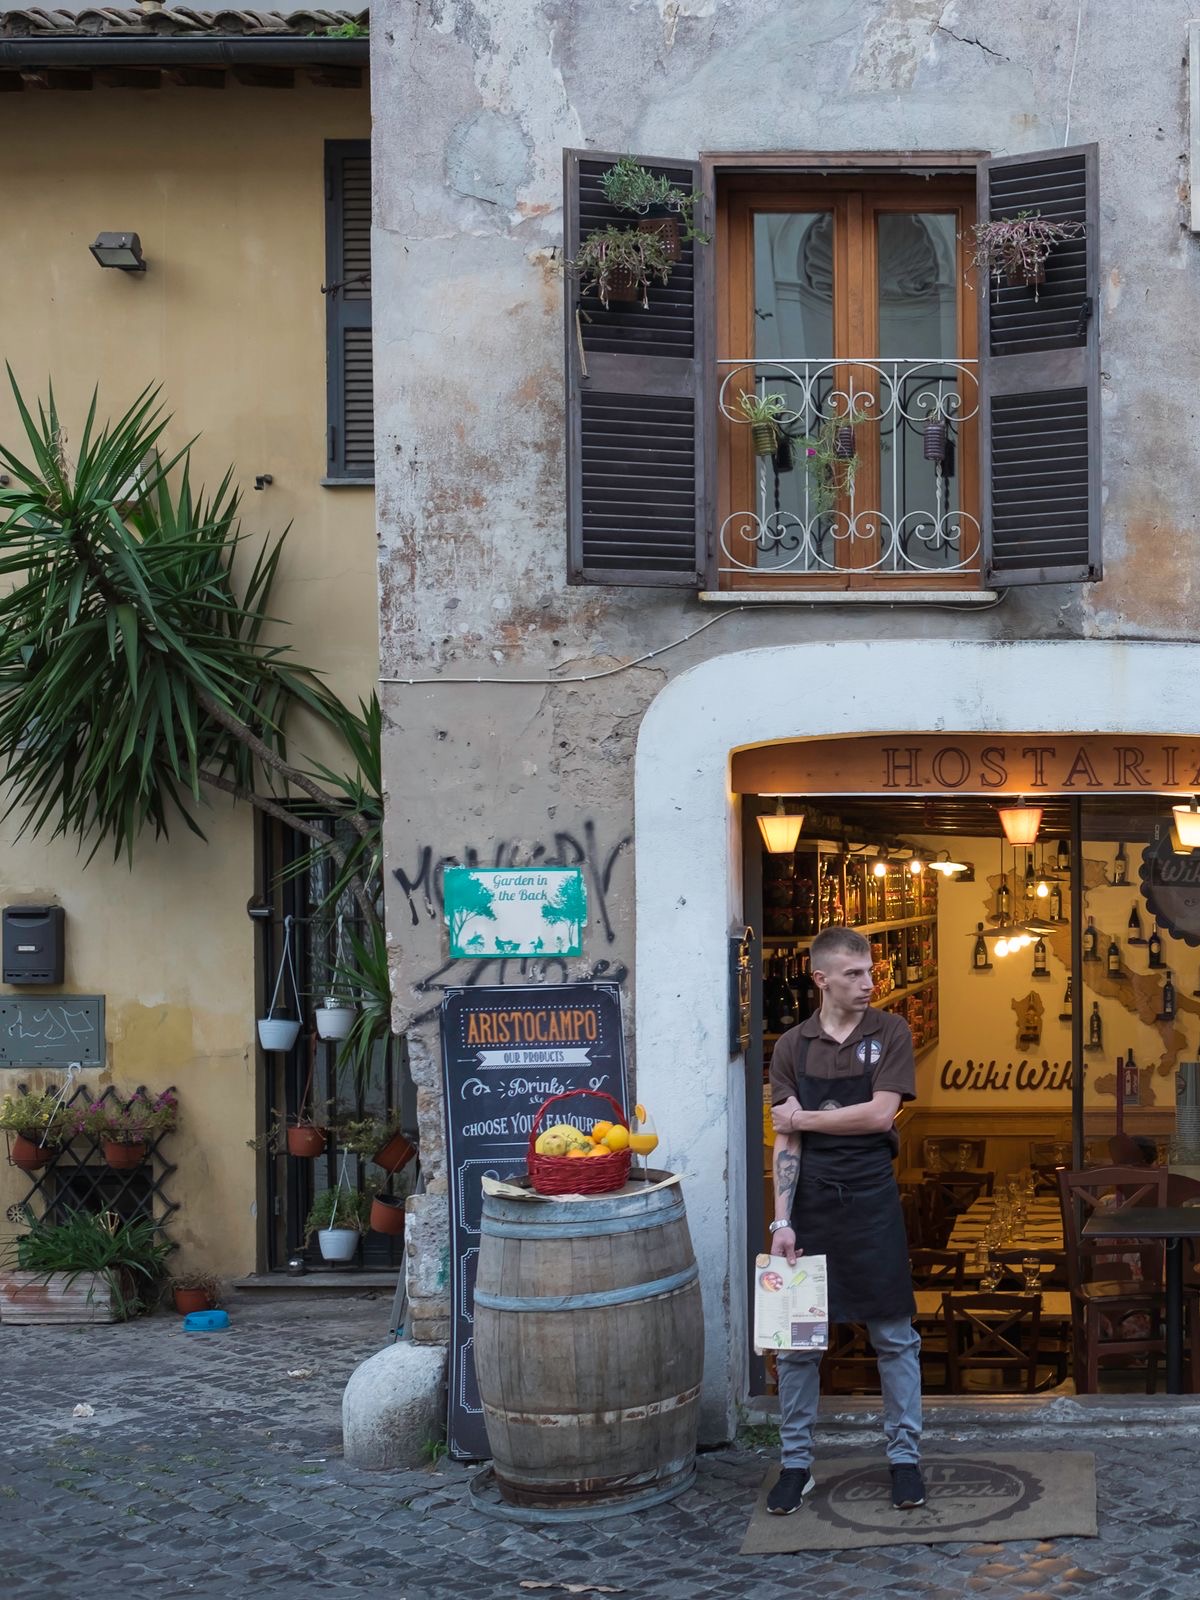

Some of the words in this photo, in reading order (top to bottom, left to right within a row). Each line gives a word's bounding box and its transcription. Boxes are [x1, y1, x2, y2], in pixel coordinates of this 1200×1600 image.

[492, 874, 535, 886] Garden
[536, 874, 548, 886] in
[498, 890, 516, 901] the
[518, 890, 548, 902] Back
[467, 1009, 597, 1044] ARISTOCAMPO
[503, 1051, 521, 1064] OUR
[523, 1050, 565, 1063] PRODUCTS
[507, 1076, 565, 1097] Drinks
[462, 1117, 509, 1137] CHOOSE
